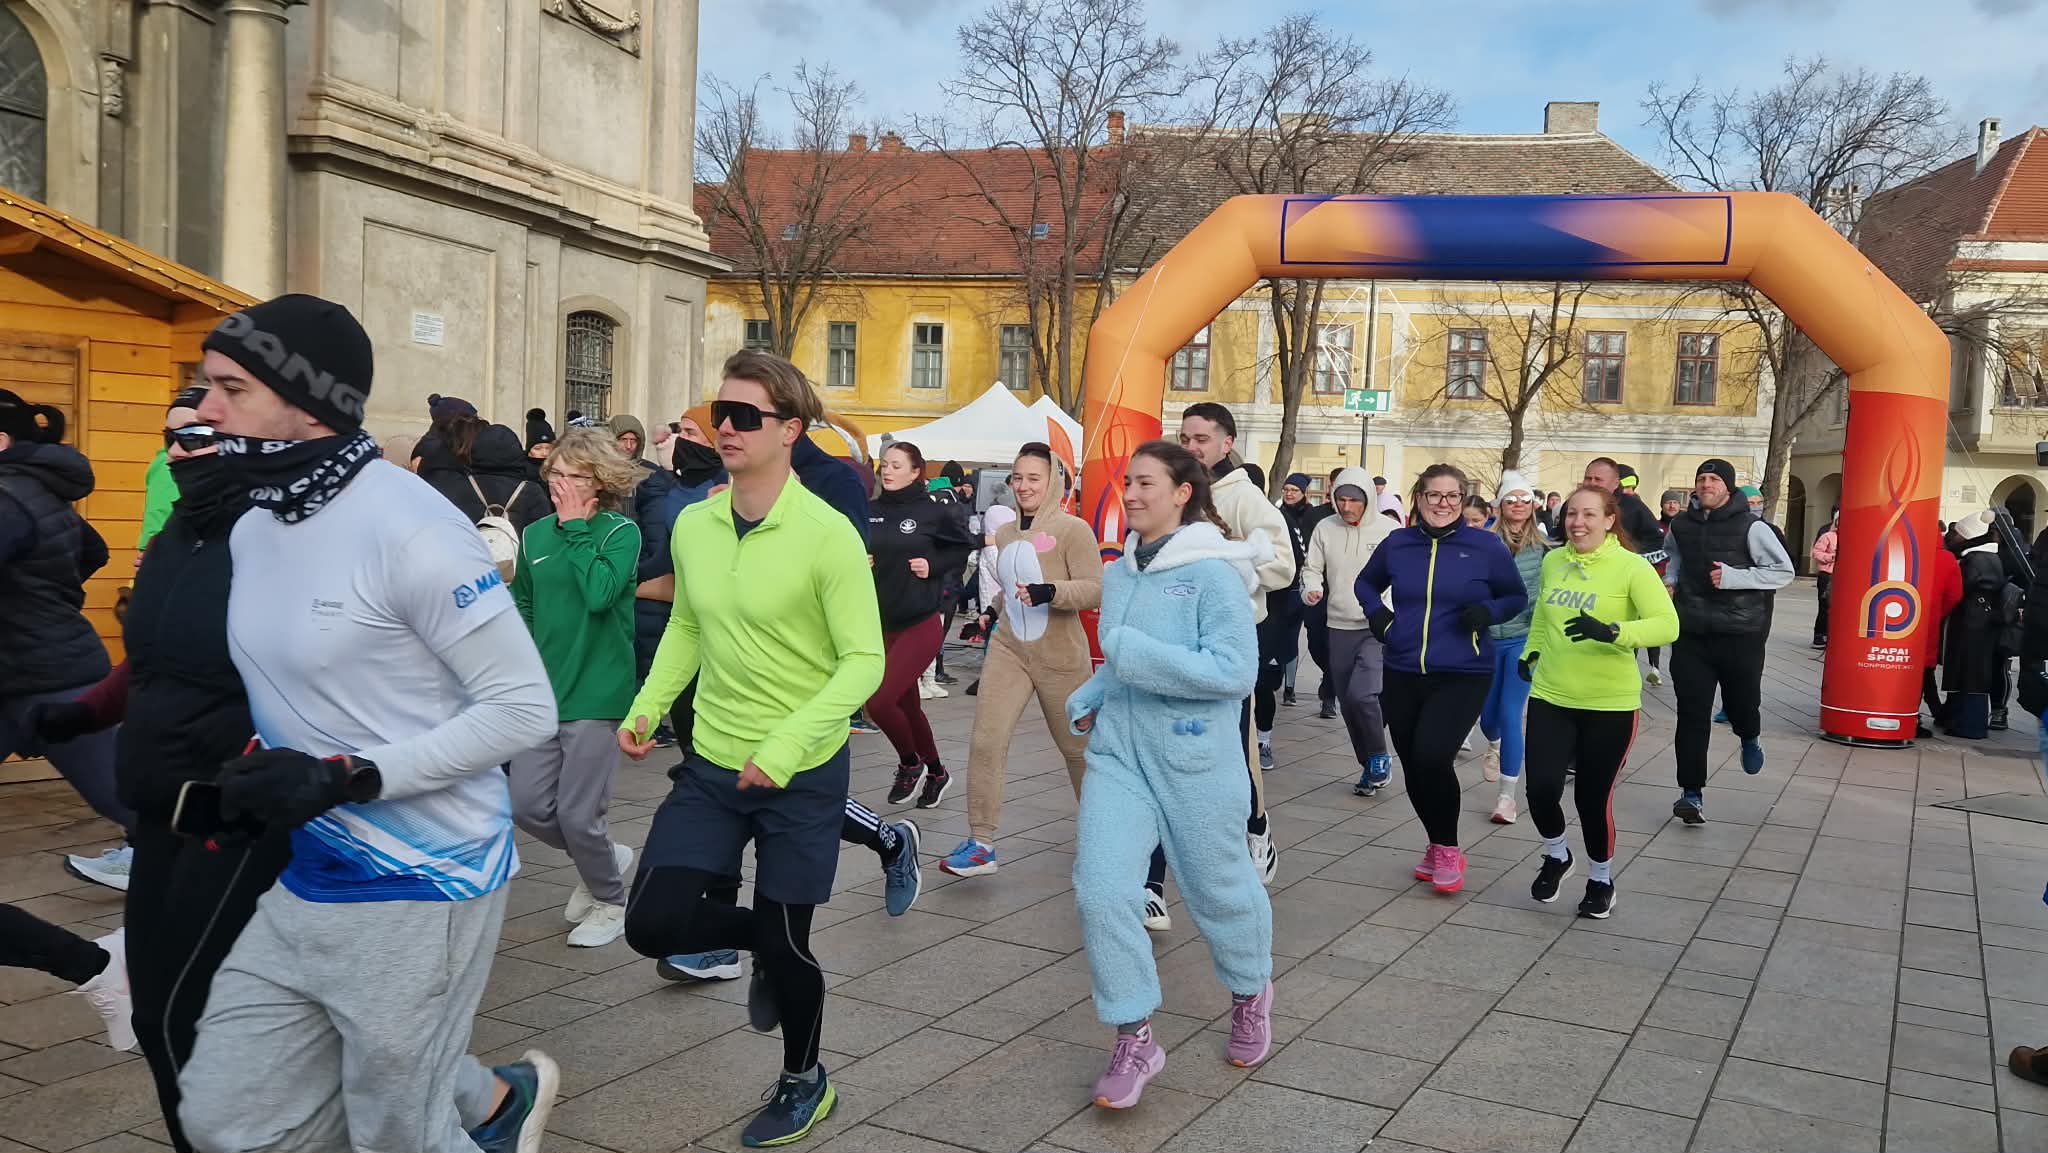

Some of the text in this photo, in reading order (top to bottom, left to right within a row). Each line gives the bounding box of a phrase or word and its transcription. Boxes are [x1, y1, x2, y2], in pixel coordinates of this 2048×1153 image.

[215, 312, 368, 421] DANG
[1545, 588, 1597, 611] ZONA
[1867, 653, 1911, 663] SPORT
